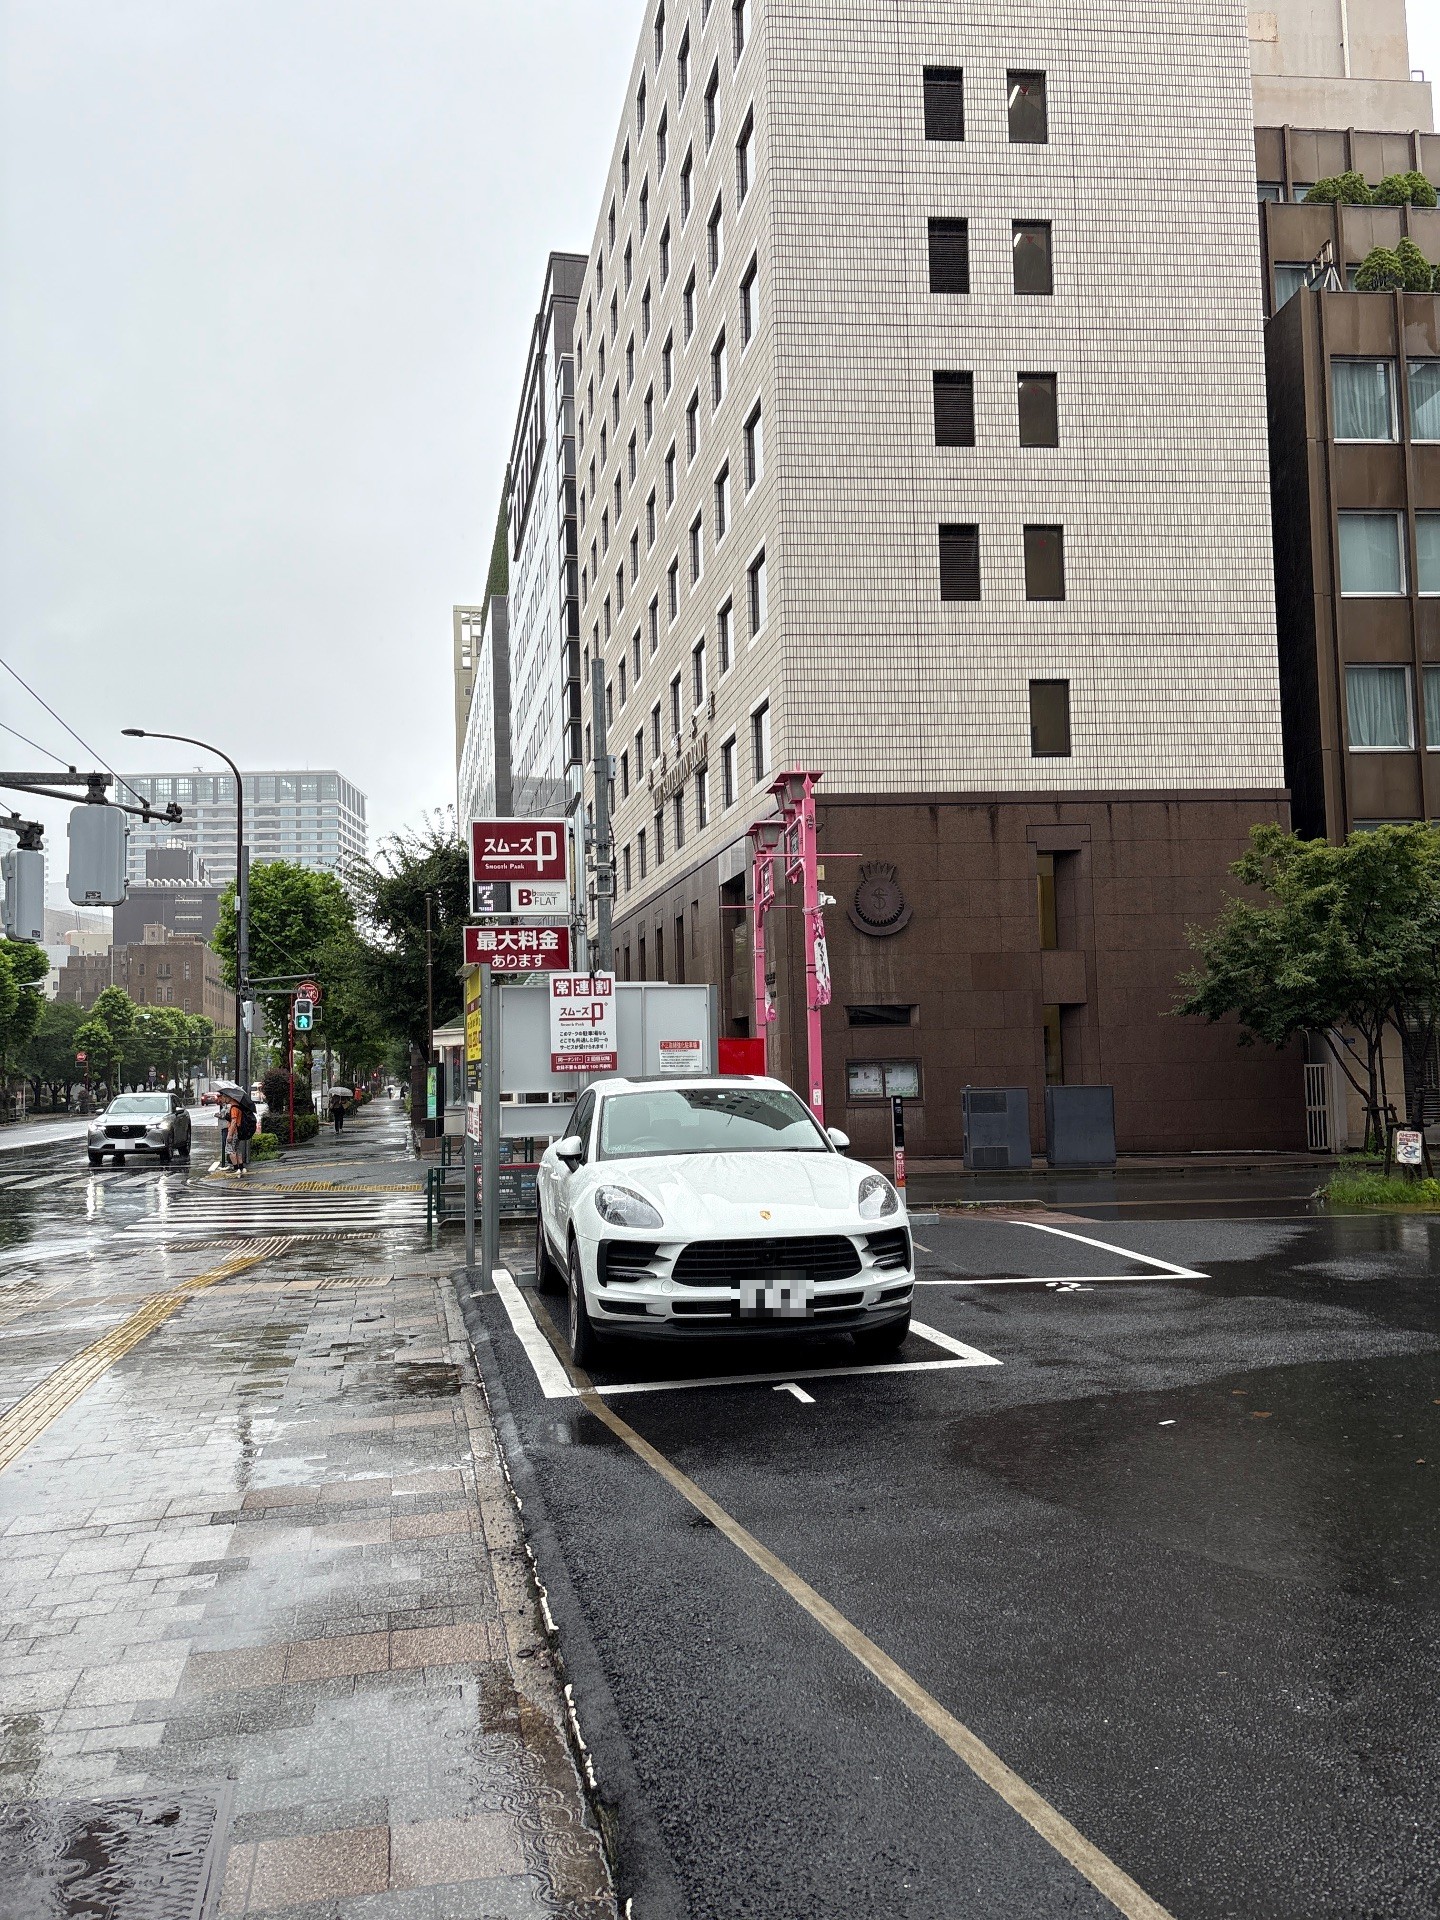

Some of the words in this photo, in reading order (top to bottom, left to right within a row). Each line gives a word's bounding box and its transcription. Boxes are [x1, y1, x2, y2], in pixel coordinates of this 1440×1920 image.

[484, 838, 533, 853] スムーズ
[534, 897, 557, 906] FLAT
[477, 930, 559, 951] 最大料金
[491, 953, 546, 968] あります
[555, 980, 610, 995] 常連割
[560, 1006, 590, 1016] スムーズ
